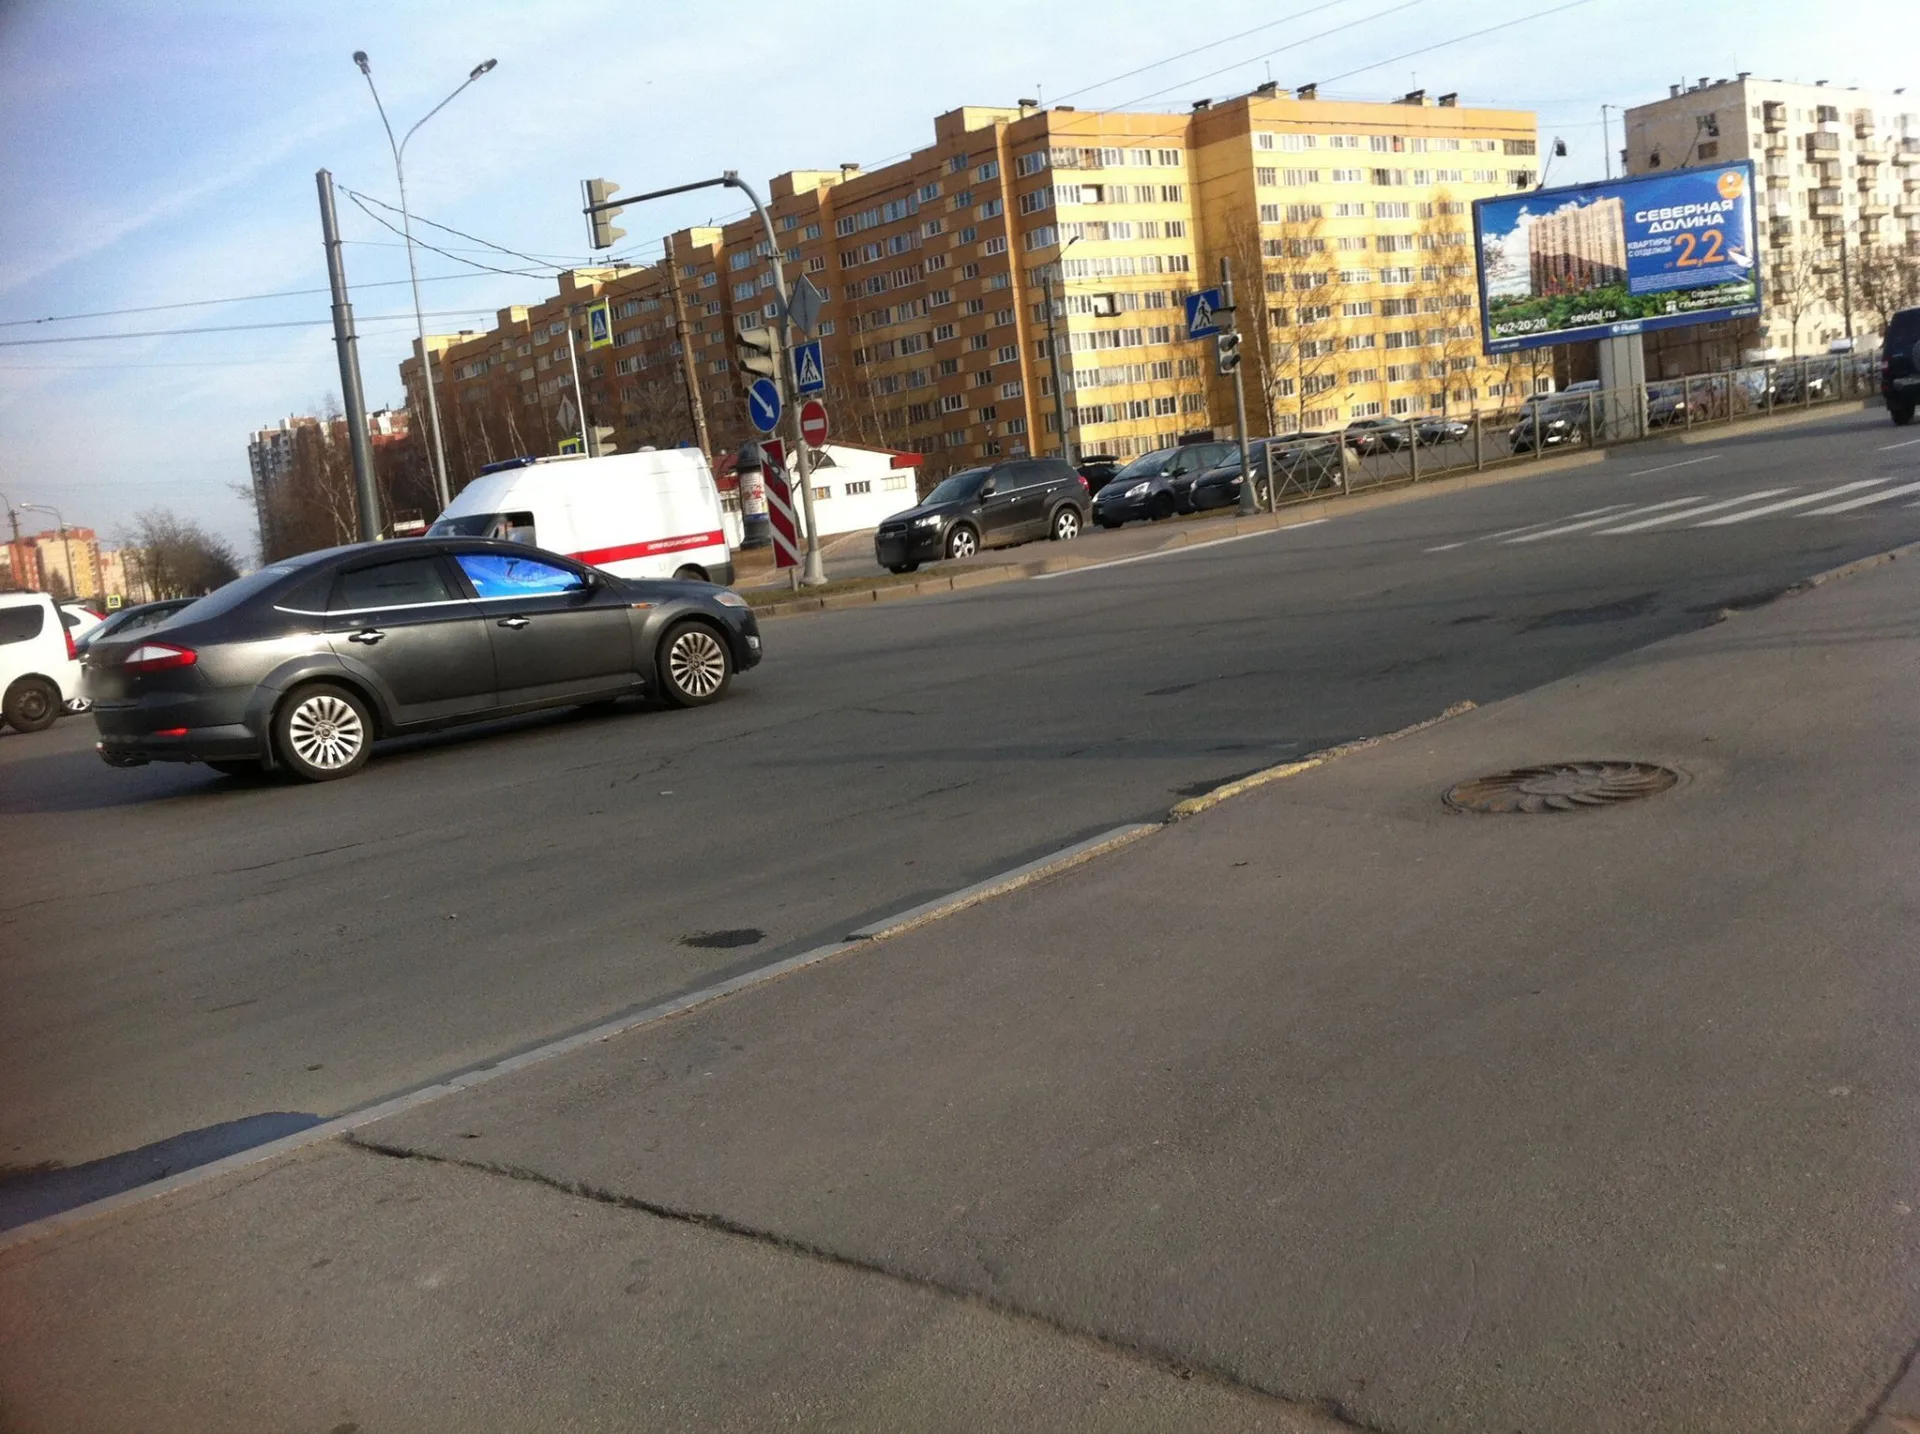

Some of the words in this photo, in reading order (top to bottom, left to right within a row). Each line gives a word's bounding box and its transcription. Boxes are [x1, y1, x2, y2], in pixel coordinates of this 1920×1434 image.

[1635, 199, 1734, 223] СЕВЕРНАЯ
[1648, 212, 1725, 234] ДОЛИНА
[1495, 317, 1547, 334] 602-20-20
[1570, 309, 1617, 324] sevdol.ru
